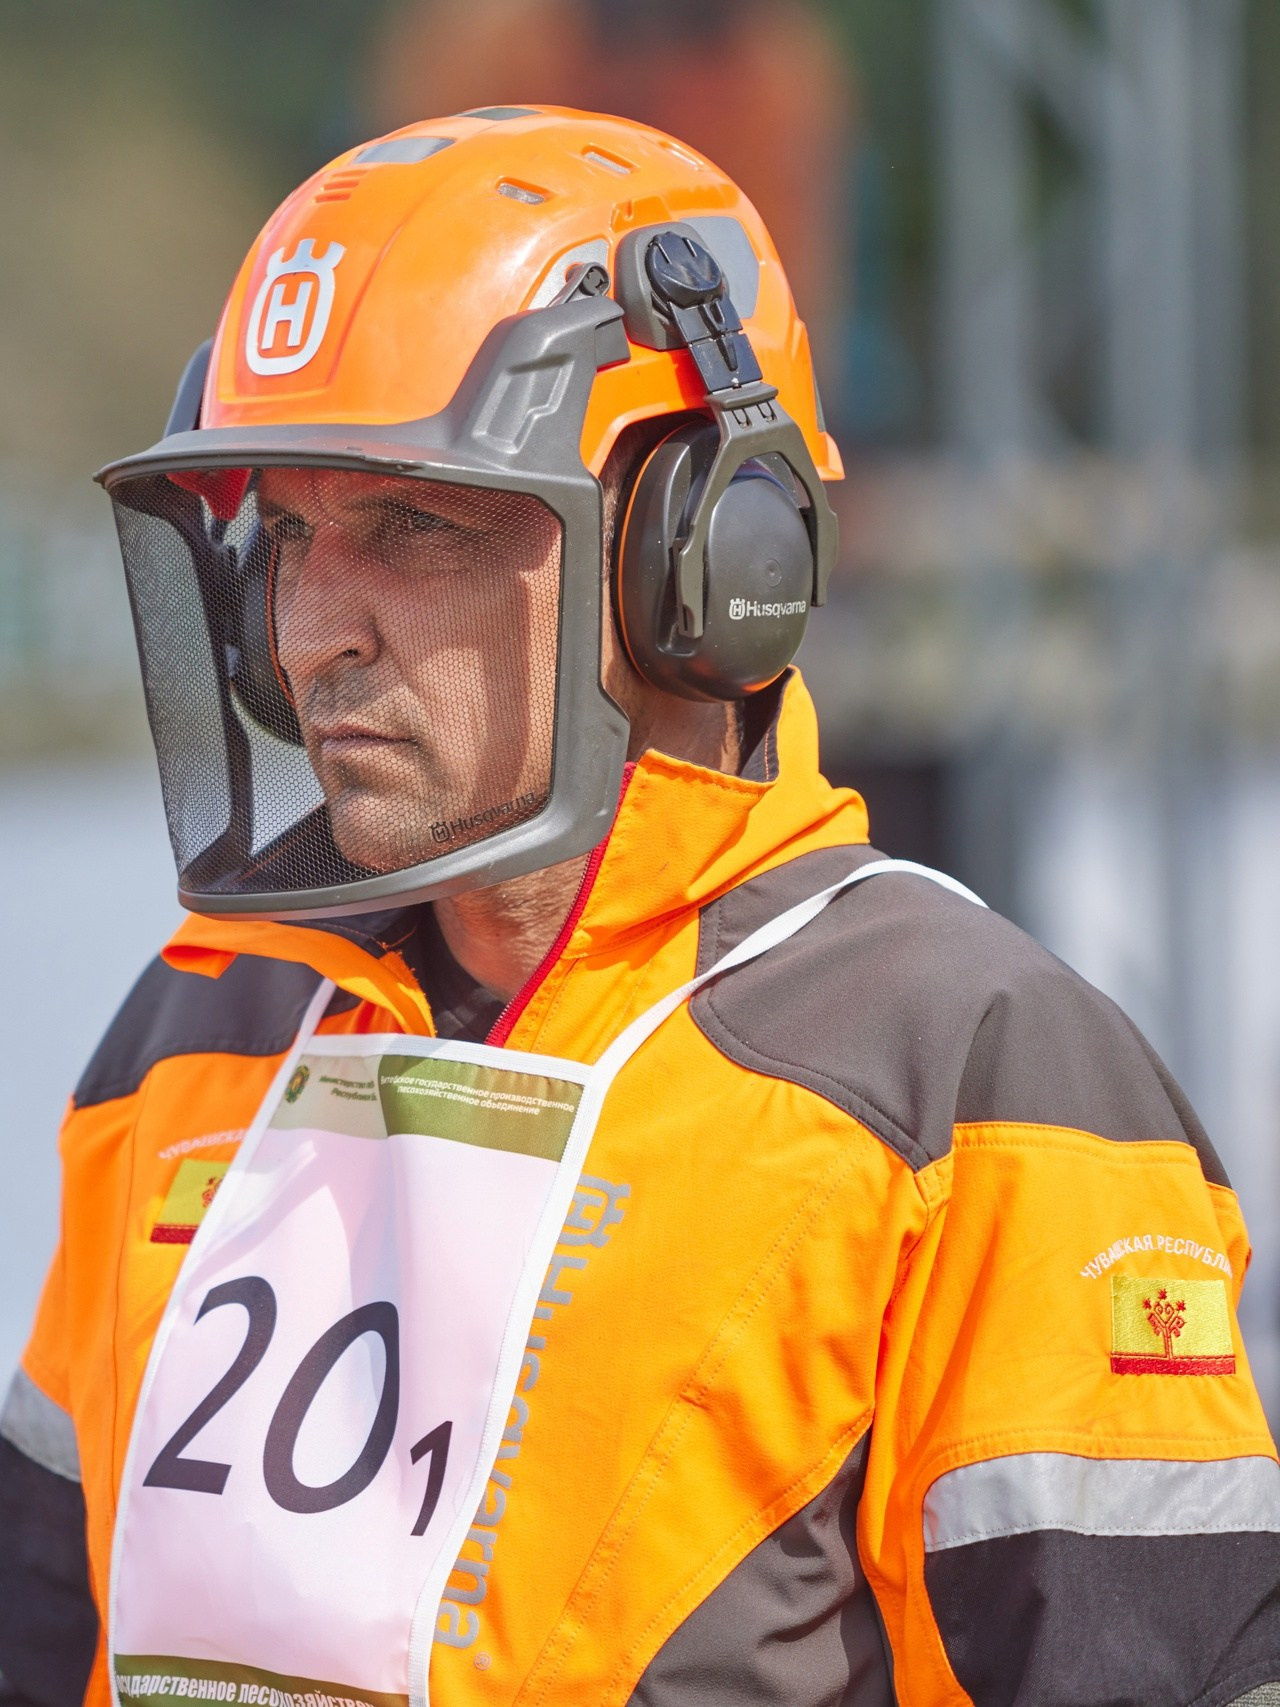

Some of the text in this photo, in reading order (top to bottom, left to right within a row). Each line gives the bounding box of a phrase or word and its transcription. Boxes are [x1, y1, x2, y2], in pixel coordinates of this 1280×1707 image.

[746, 600, 806, 618] Husqvarna
[450, 792, 535, 835] Husqvarna
[415, 1078, 489, 1097] государственное
[490, 1091, 574, 1112] производственное
[480, 1099, 540, 1115] объединение
[1157, 1234, 1233, 1279] РЕСПУБЛИ
[116, 1674, 375, 1707] осударственное лесохозяйст
